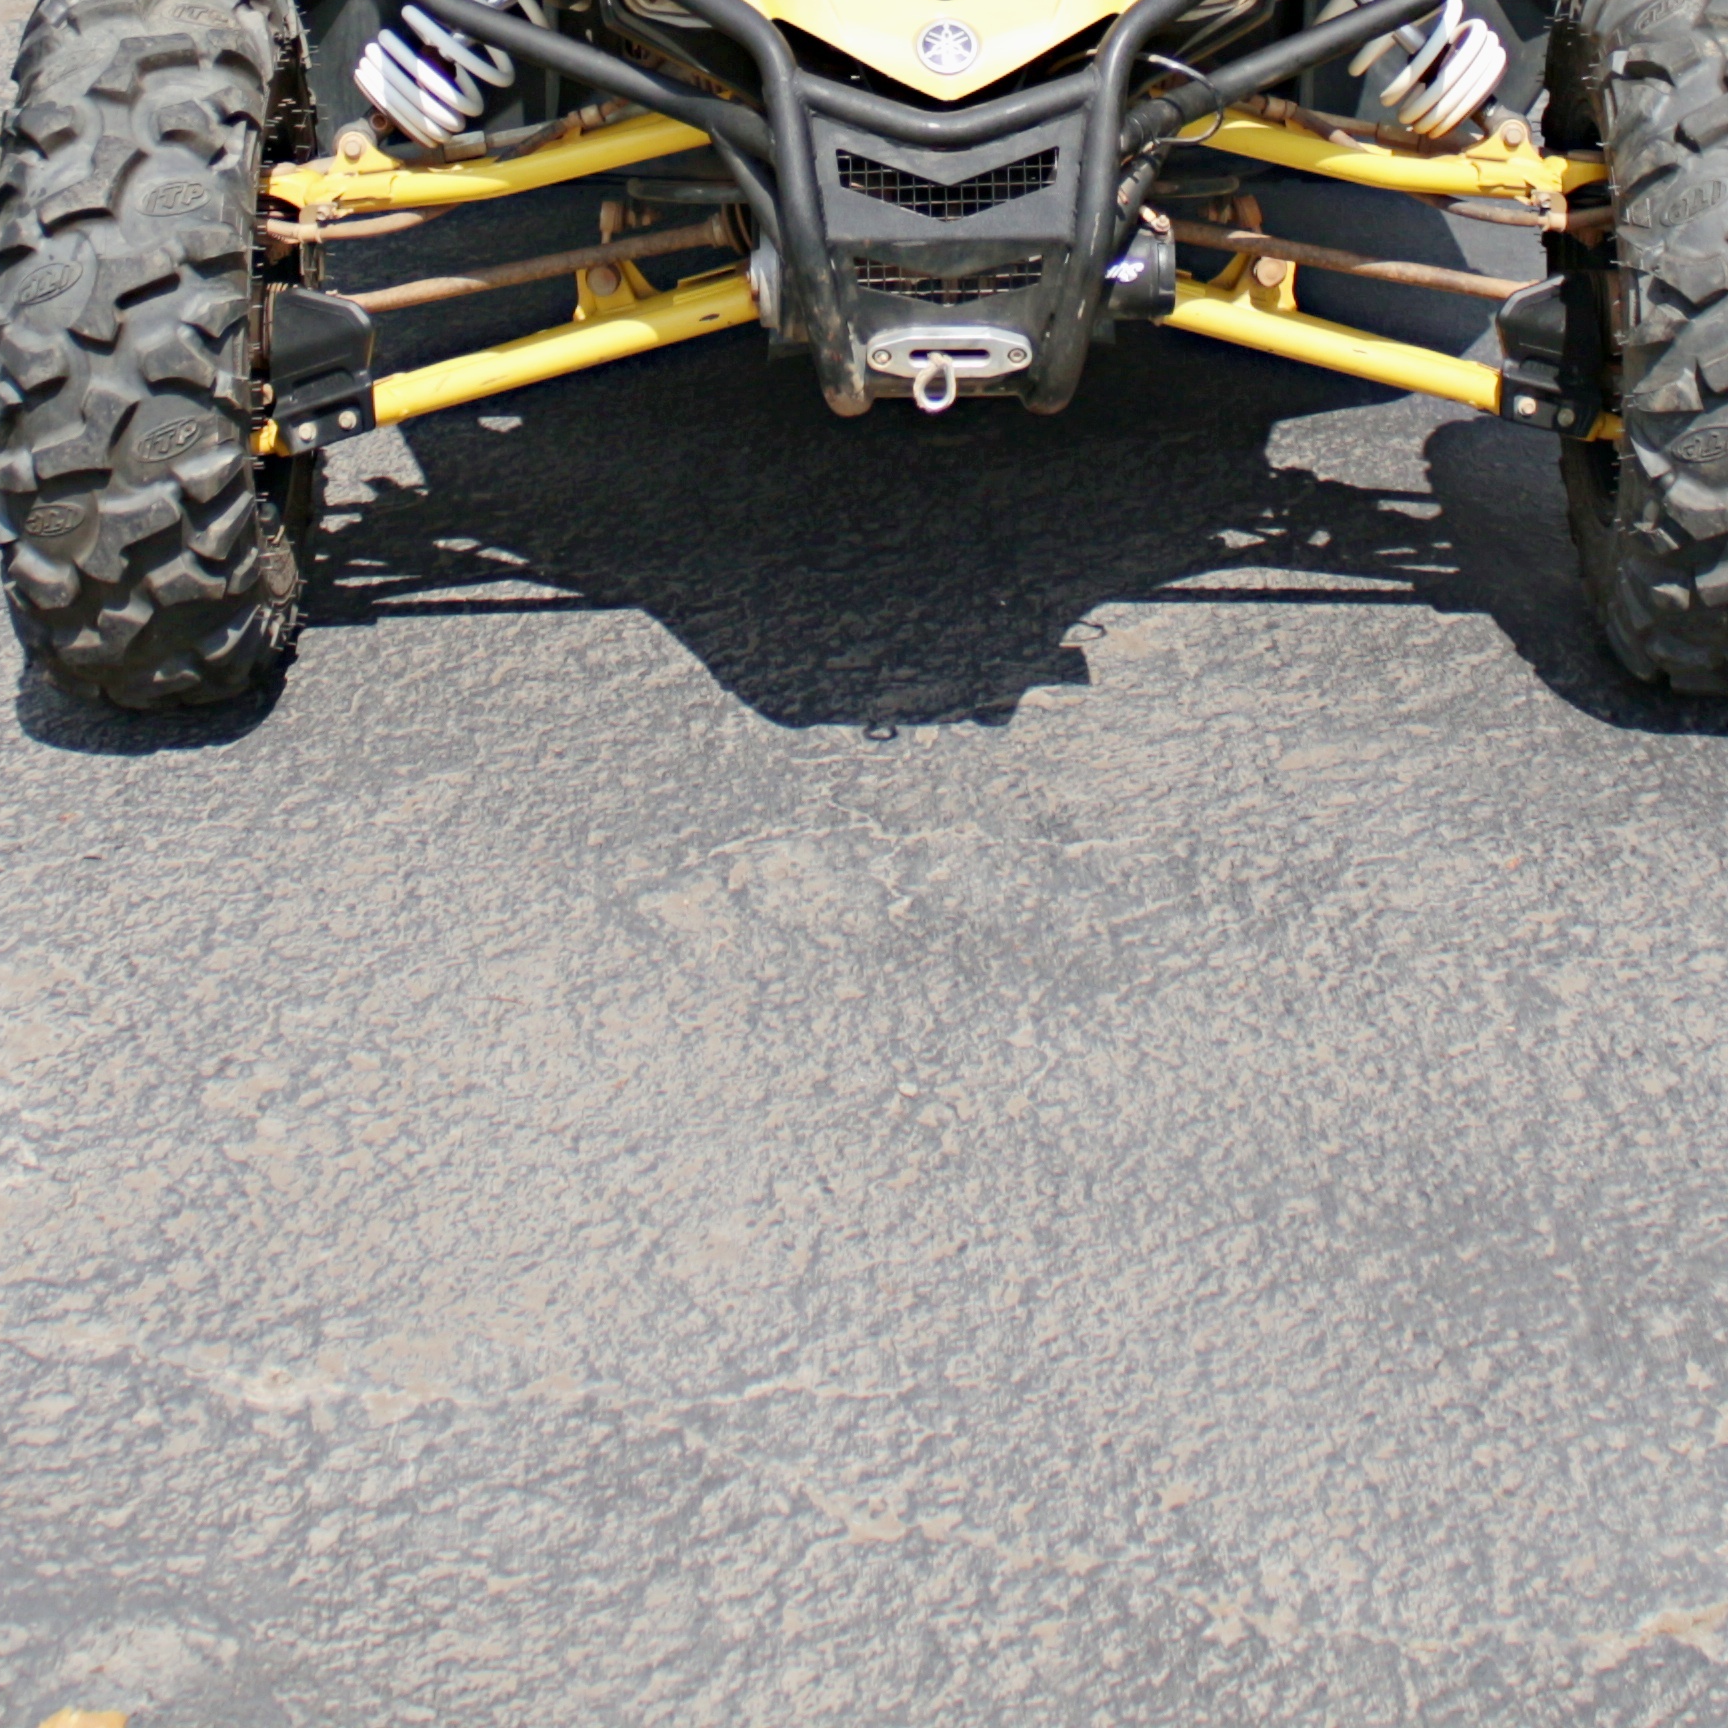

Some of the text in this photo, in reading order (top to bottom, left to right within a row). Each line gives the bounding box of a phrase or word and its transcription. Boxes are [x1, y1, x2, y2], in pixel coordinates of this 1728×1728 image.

[145, 183, 205, 212] ITP
[1668, 180, 1722, 225] ITP
[20, 264, 71, 303] ITP
[142, 419, 197, 459] ITP
[25, 508, 74, 535] ITP
